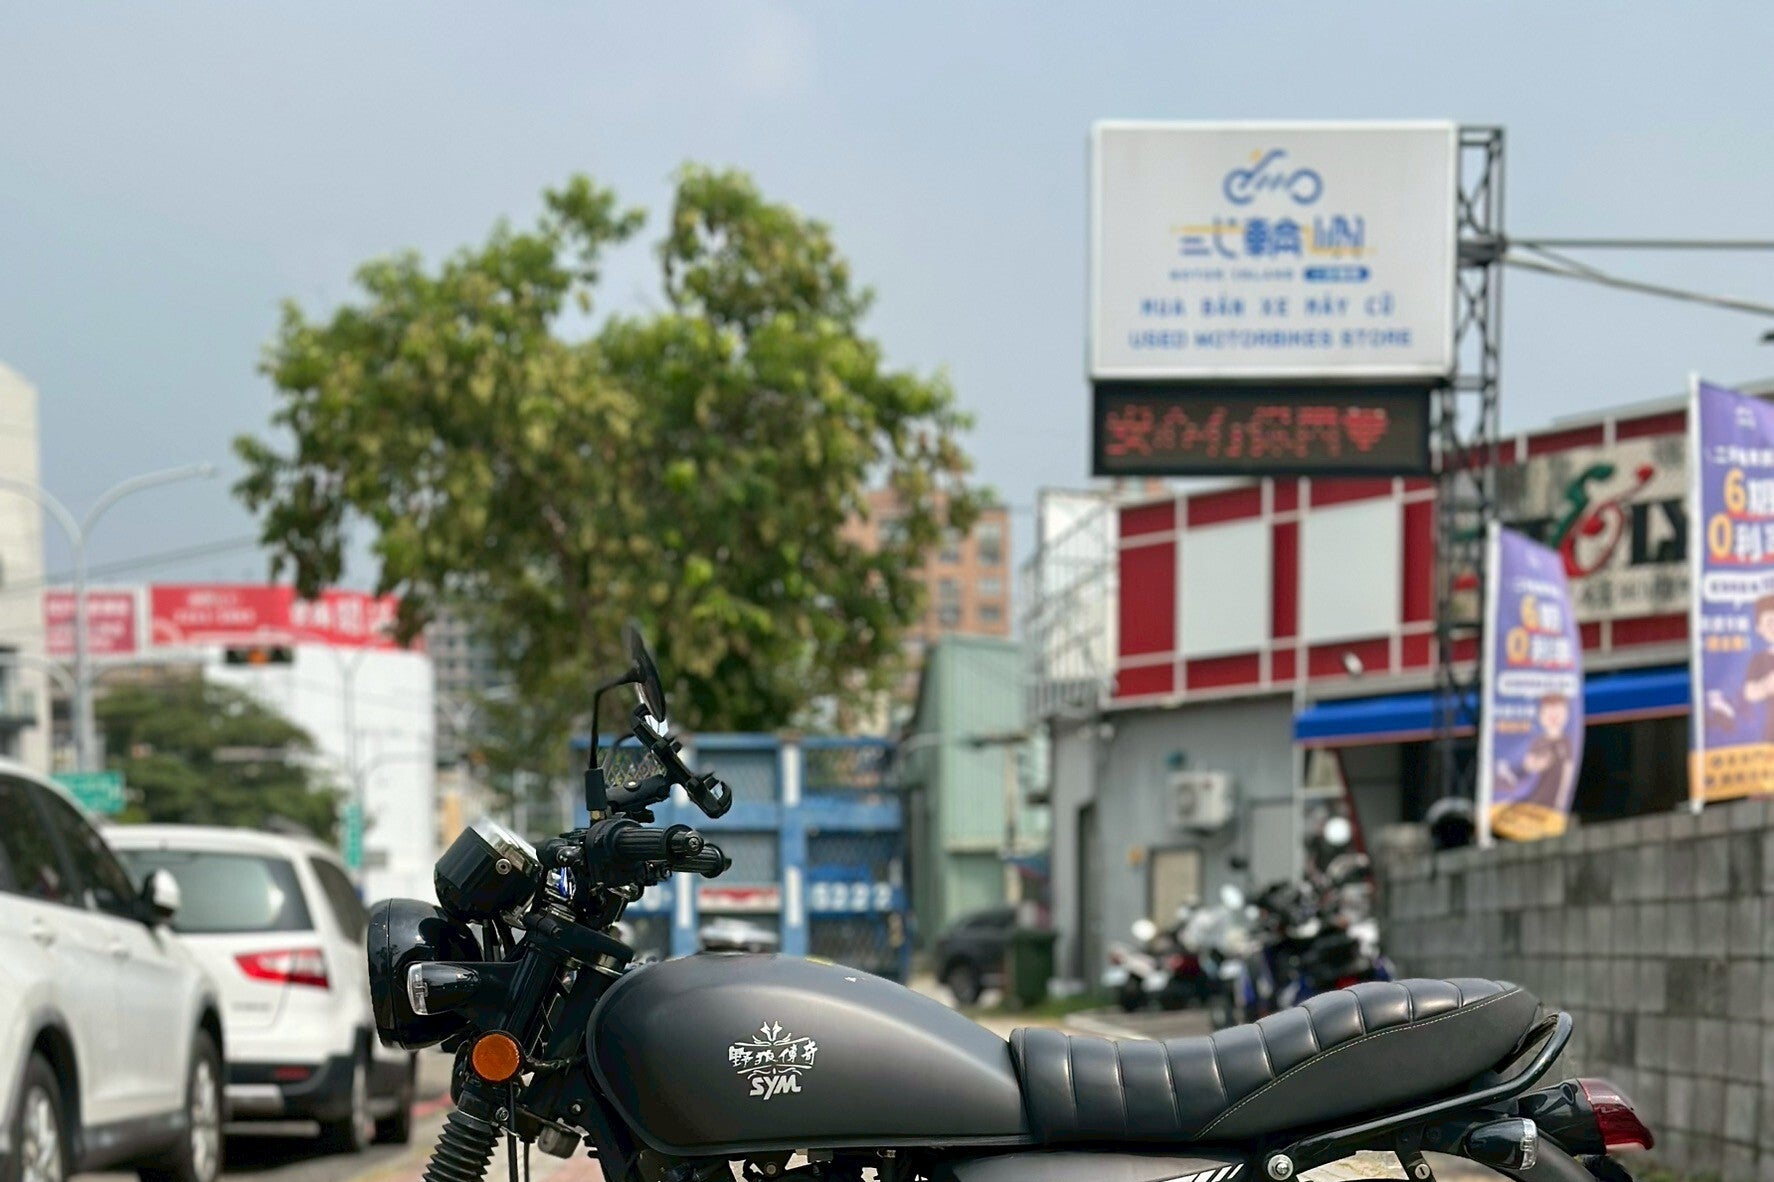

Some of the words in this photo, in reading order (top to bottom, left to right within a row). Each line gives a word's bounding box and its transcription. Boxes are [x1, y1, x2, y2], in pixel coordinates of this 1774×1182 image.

[728, 1040, 818, 1068] 野狼傳奇
[749, 1074, 802, 1100] SYM
